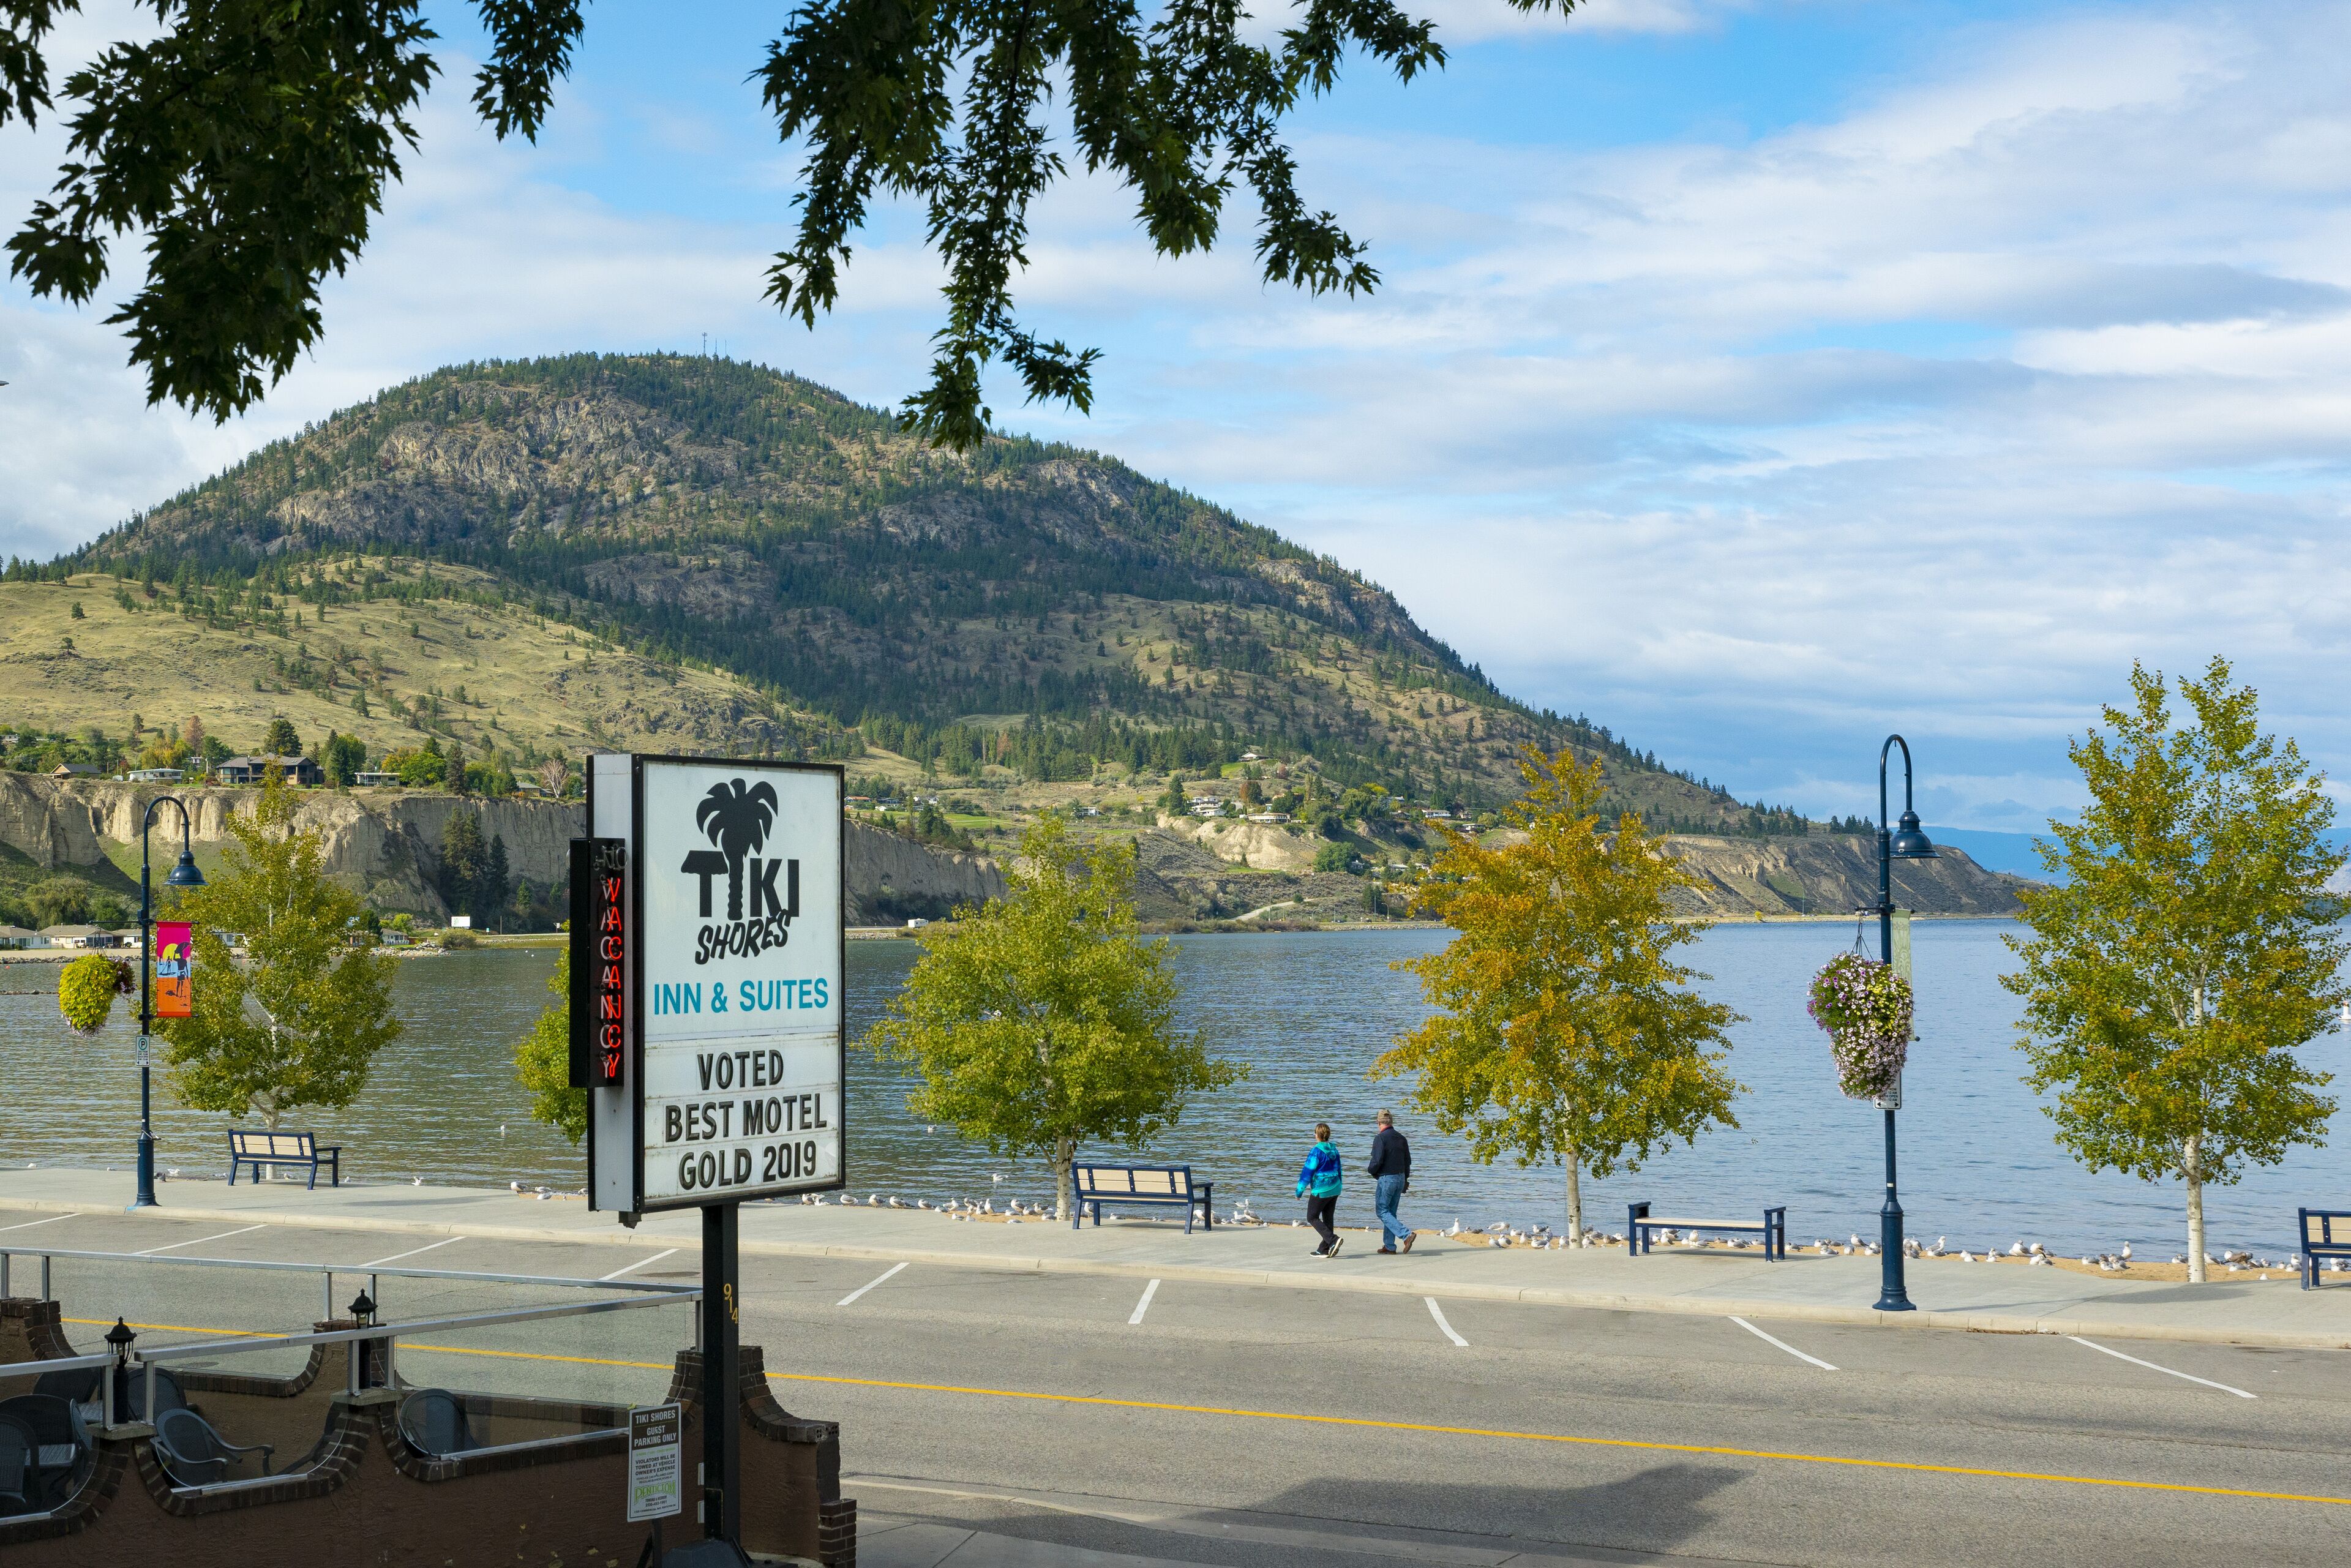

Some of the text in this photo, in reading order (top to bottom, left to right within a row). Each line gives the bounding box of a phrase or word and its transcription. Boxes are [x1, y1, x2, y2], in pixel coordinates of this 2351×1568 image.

[602, 846, 629, 869] NO
[681, 850, 800, 920] TIKI
[695, 909, 792, 965] SHORES
[605, 877, 623, 1078] VACANCY
[654, 978, 828, 1015] INN & SUITES
[697, 1049, 784, 1091] VOTED
[666, 1093, 827, 1142] BEST MOTEL
[679, 1140, 816, 1190] GOLD 2019
[724, 1283, 738, 1324] 914
[636, 1409, 675, 1424] TIKI SHORES
[647, 1425, 666, 1436] GUEST
[634, 1433, 677, 1447] PARKING ONLY
